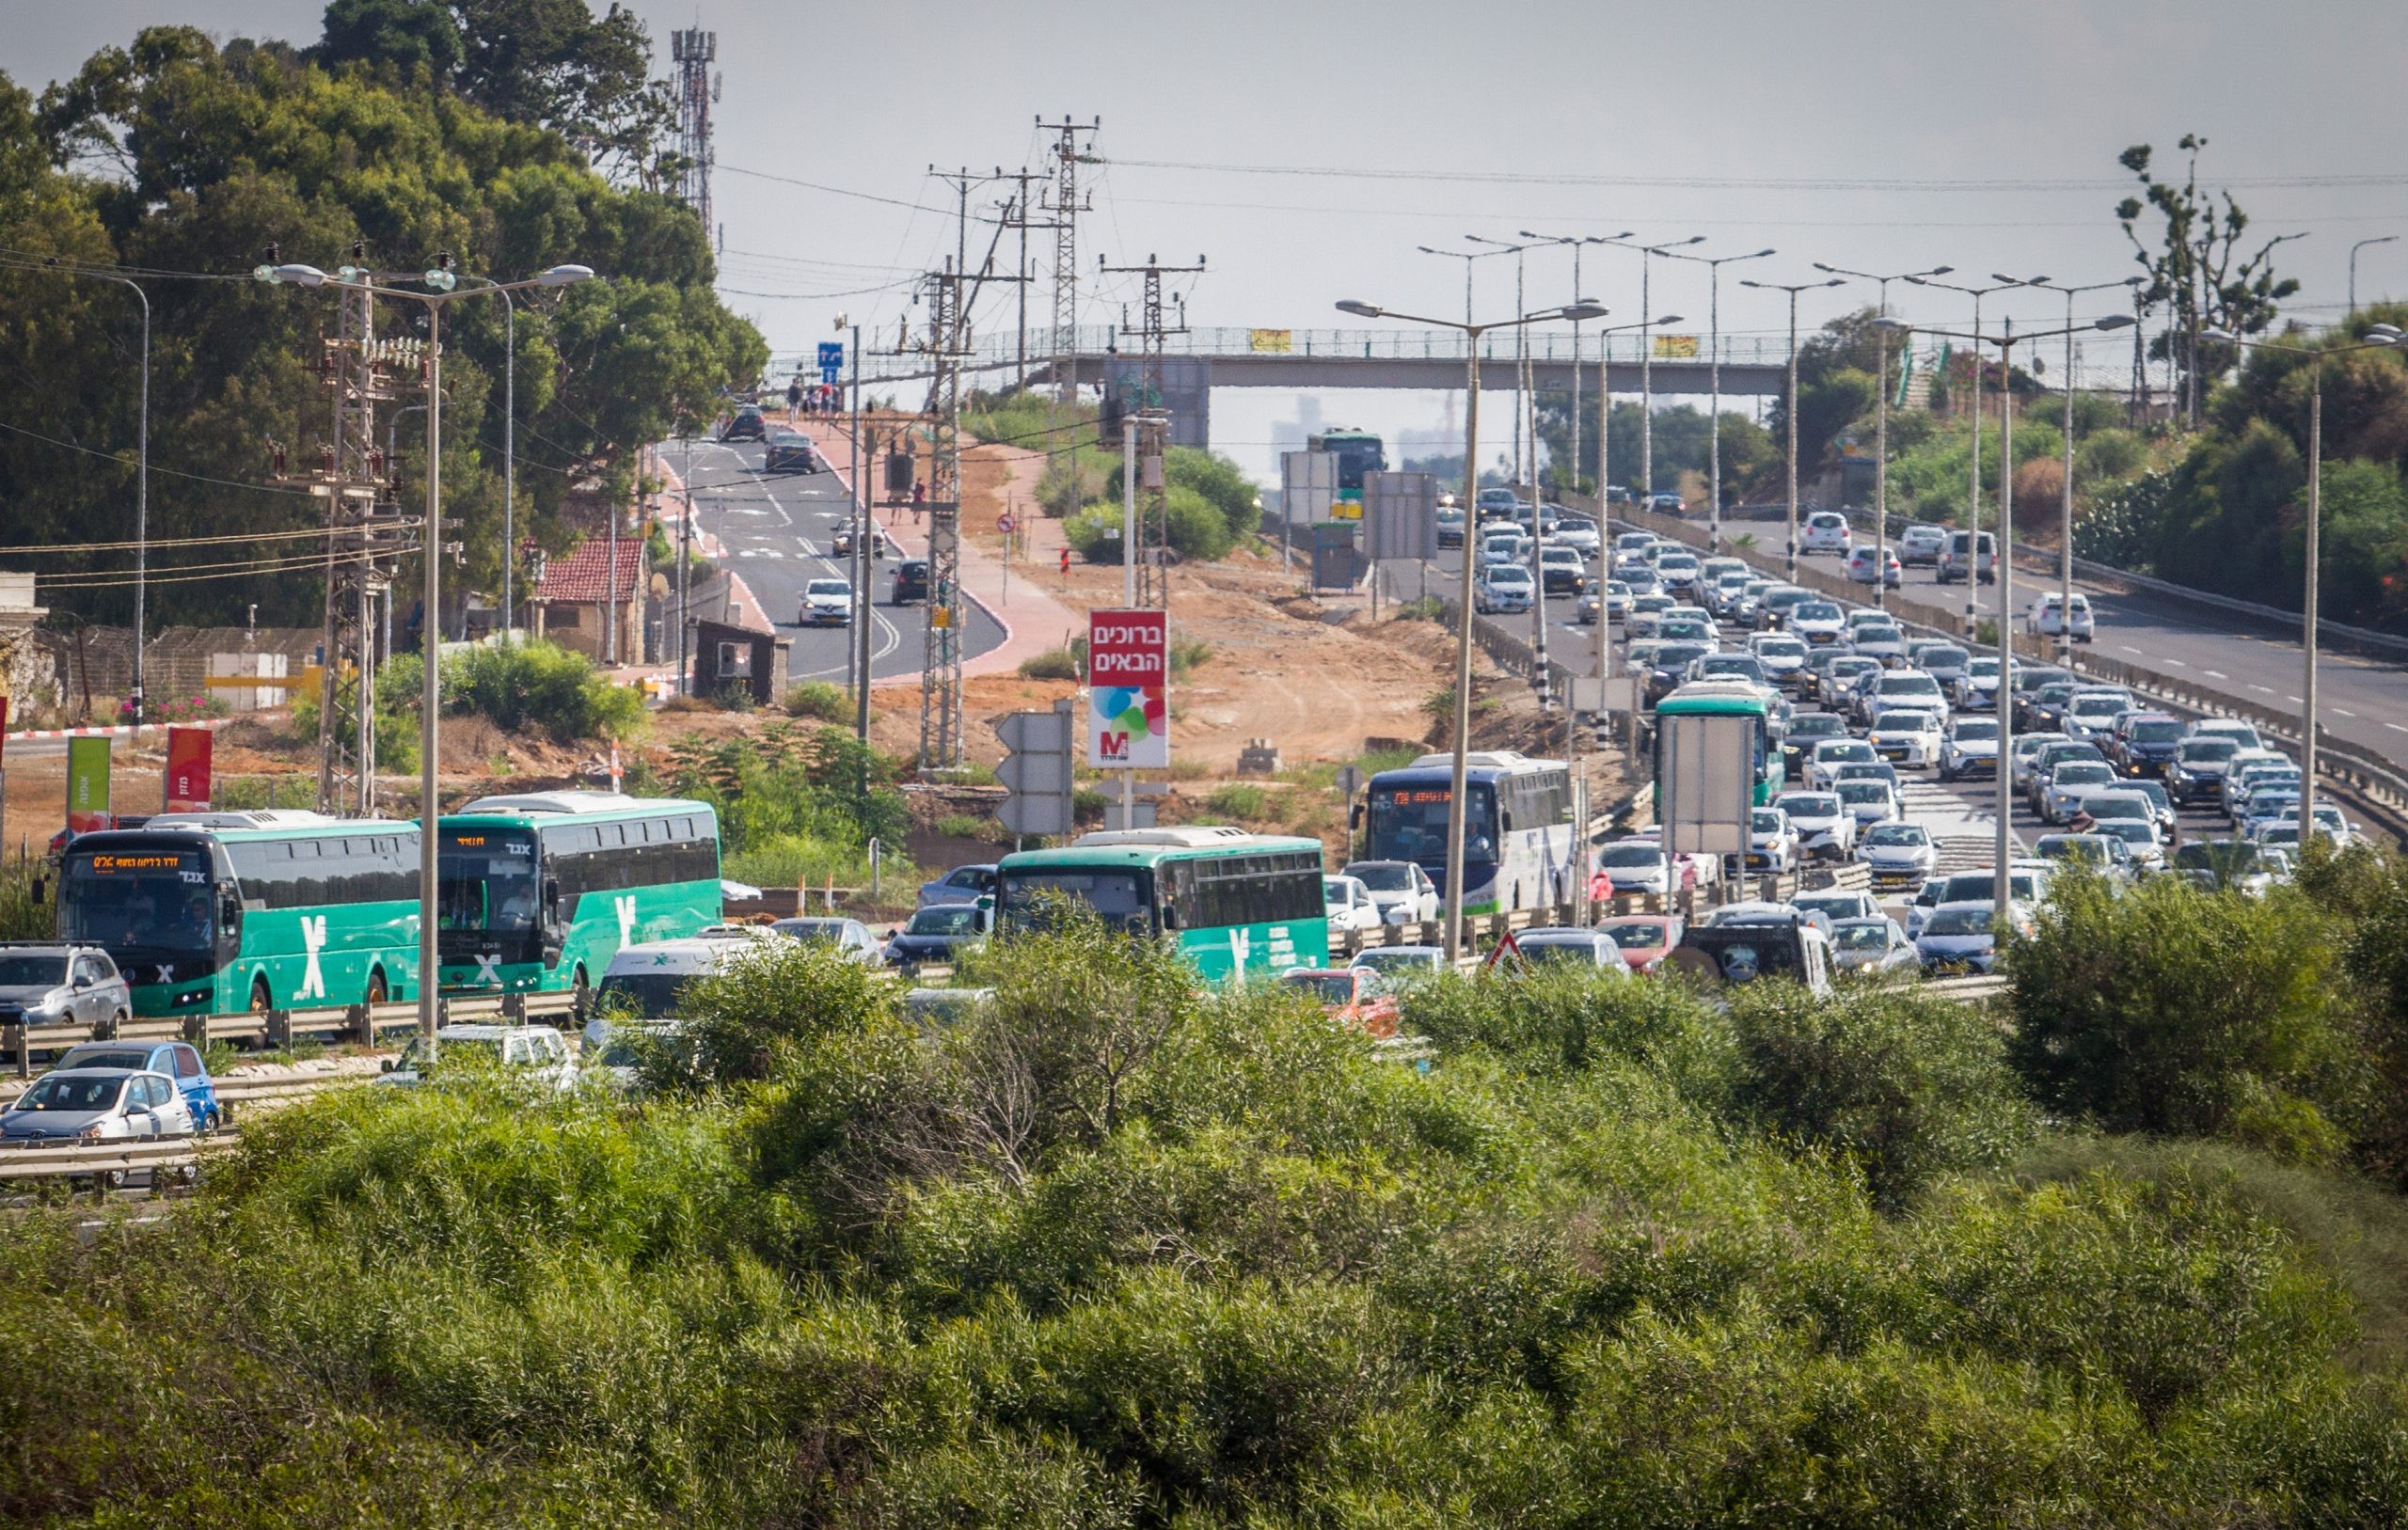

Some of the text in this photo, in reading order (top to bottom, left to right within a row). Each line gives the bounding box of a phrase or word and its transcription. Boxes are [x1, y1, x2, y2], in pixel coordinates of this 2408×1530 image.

[1094, 625, 1163, 644] ברוכים
[1095, 653, 1161, 671] הבאים
[505, 843, 531, 856] אגד
[179, 870, 206, 884] אגד
